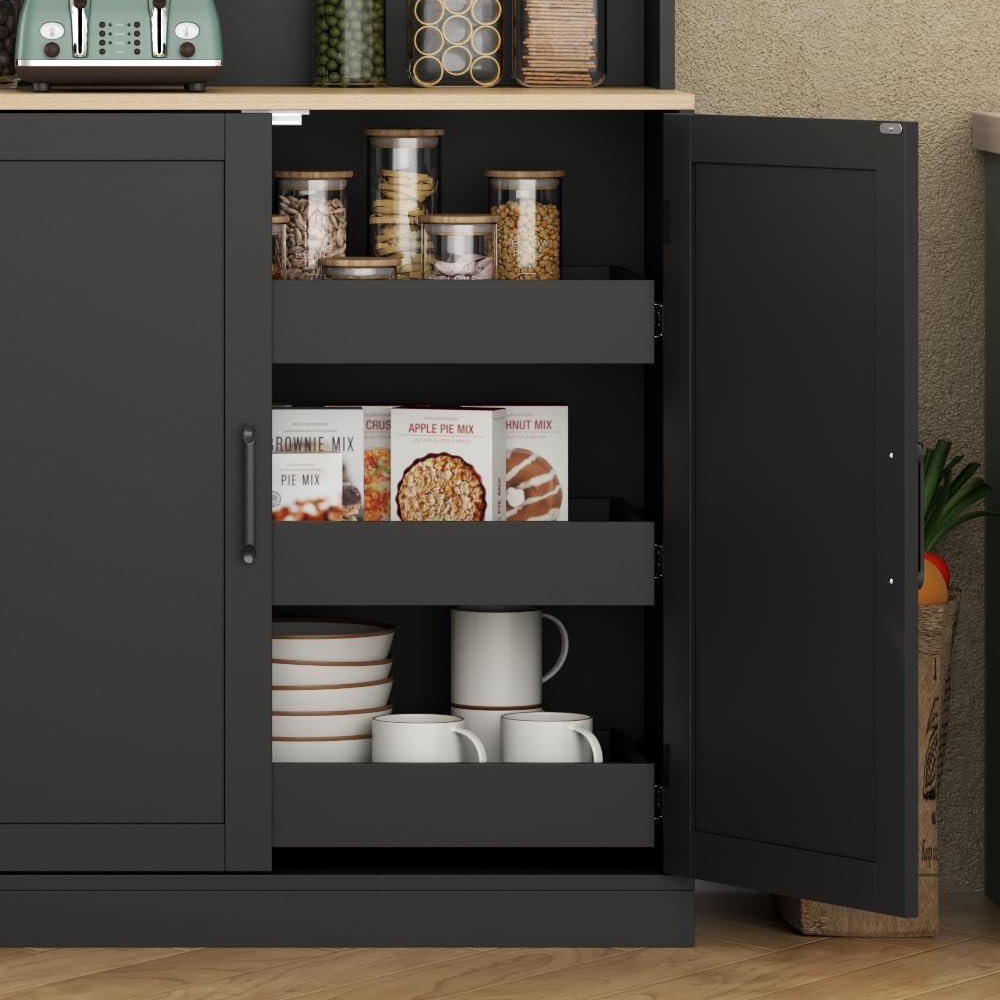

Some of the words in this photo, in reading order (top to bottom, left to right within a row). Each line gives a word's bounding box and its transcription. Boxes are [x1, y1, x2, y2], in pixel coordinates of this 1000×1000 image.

[408, 423, 438, 434] APPLE
[440, 423, 455, 434] PIE
[457, 424, 475, 435] MIX
[505, 420, 532, 430] HNUT
[534, 420, 553, 430] MIX
[331, 436, 355, 452] MIX
[281, 474, 297, 487] PIE
[302, 474, 321, 487] MIX
